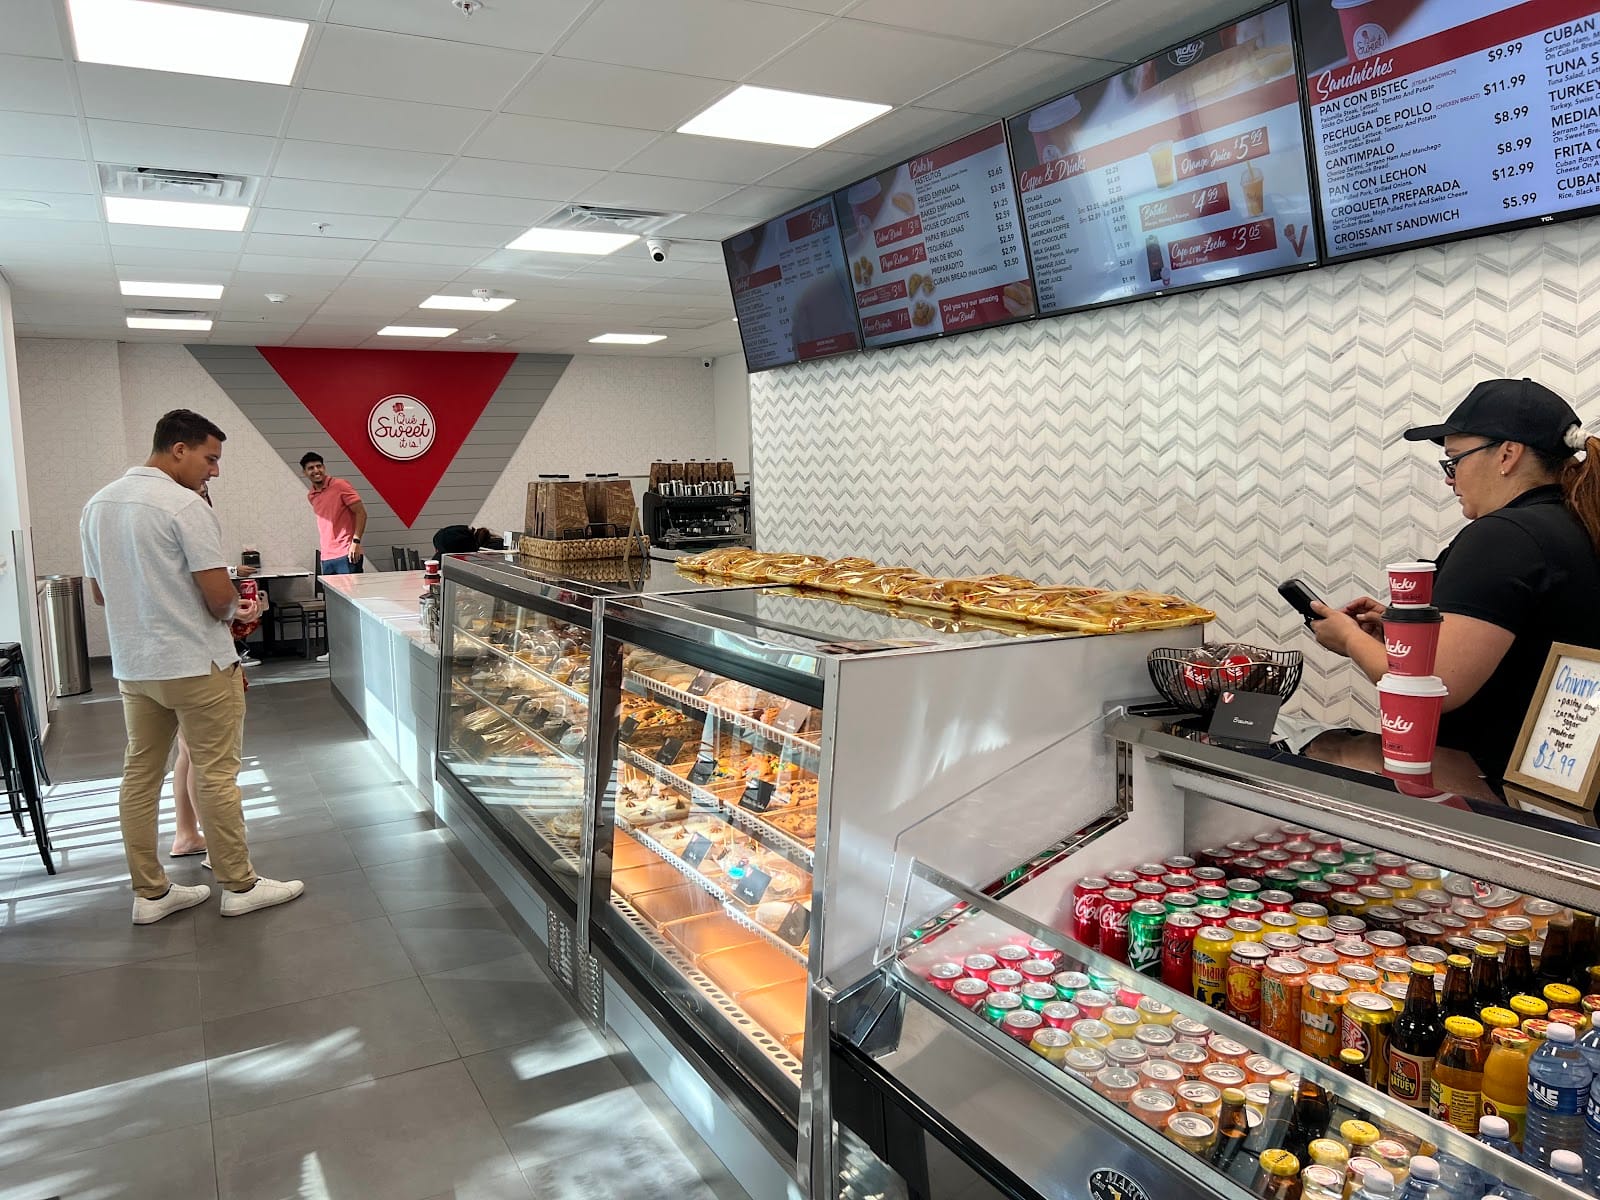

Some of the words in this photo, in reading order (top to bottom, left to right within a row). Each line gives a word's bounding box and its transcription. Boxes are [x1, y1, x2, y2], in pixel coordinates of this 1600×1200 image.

[1544, 18, 1595, 44] CUBAN
[1488, 42, 1523, 62] $9.99
[1545, 43, 1571, 54] Serrano
[1546, 53, 1555, 61] On
[1557, 46, 1579, 58] Cuban
[1546, 56, 1587, 77] TUNA
[1316, 57, 1394, 101] Sandwiches
[1484, 74, 1526, 96] $11.99
[1548, 78, 1563, 87] Tuna
[1319, 103, 1340, 116] PAN
[1343, 92, 1368, 108] CON
[1371, 79, 1409, 100] BISTEC
[1404, 90, 1414, 98] And
[1575, 96, 1594, 106] Swiss
[1322, 120, 1374, 144] PECHUGA
[1376, 114, 1392, 128] DE
[1394, 102, 1432, 122] POLLO
[1405, 119, 1416, 128] And
[1494, 106, 1529, 124] $8.99
[1552, 105, 1600, 128] MEDIA
[1552, 126, 1578, 137] Serrano
[1564, 130, 1586, 141] Sweet
[1400, 148, 1412, 157] And
[1413, 142, 1442, 154] Manchego
[1498, 136, 1532, 155] $8.99
[1554, 142, 1592, 160] FRITA
[1182, 158, 1209, 174] Orange
[1210, 148, 1232, 166] Juice
[1326, 143, 1395, 170] CANTIMPALO
[1556, 159, 1577, 168] Cuban
[914, 170, 942, 186] PASTELITOS
[988, 166, 1003, 178] $3.65
[1020, 172, 1042, 192] Coffee
[1044, 163, 1054, 182] &
[1055, 155, 1086, 180] Drinks
[1492, 162, 1534, 181] $12.99
[1556, 165, 1580, 175] Cheese
[1329, 184, 1350, 197] PAN
[1352, 177, 1376, 191] CON
[1380, 164, 1427, 184] LECHON
[1374, 184, 1392, 194] Grilled
[932, 184, 960, 200] EMPANADA
[1332, 197, 1389, 218] CROQUETA
[1392, 180, 1460, 204] PREPARADA
[1431, 194, 1446, 204] Swiss
[1448, 190, 1468, 200] Cheese
[1502, 192, 1537, 208] $5.99
[1558, 192, 1574, 201] Rice,
[1576, 187, 1594, 196] Black
[920, 207, 936, 218] BAKED
[938, 197, 966, 212] EMPANADA
[923, 222, 940, 233] HOUSE
[940, 211, 970, 226] CROQUETTE
[993, 197, 1008, 210] $1.25
[925, 233, 940, 244] PAPAS
[940, 224, 965, 238] RELLENAS
[996, 210, 1010, 221] $2.59
[998, 222, 1012, 232] $2.59
[1041, 218, 1050, 226] CON
[1334, 224, 1393, 244] CROISSANT
[1396, 208, 1460, 232] SANDWICH
[929, 255, 940, 264] PAN
[940, 253, 946, 261] DE
[1000, 234, 1015, 244] $2.59
[1202, 236, 1227, 254] Leche
[931, 260, 964, 276] PREPARADITO
[1002, 245, 1016, 256] $2.99
[934, 275, 950, 286] CUBAN
[951, 271, 968, 282] BREAD
[1004, 257, 1019, 268] $3.50
[978, 294, 999, 304] amazing
[374, 416, 430, 438] Sweet
[400, 438, 408, 448] it
[1556, 664, 1600, 698] Chiviric
[1562, 718, 1581, 730] sugar
[1549, 727, 1576, 740] powdered
[1554, 739, 1572, 752] sugar
